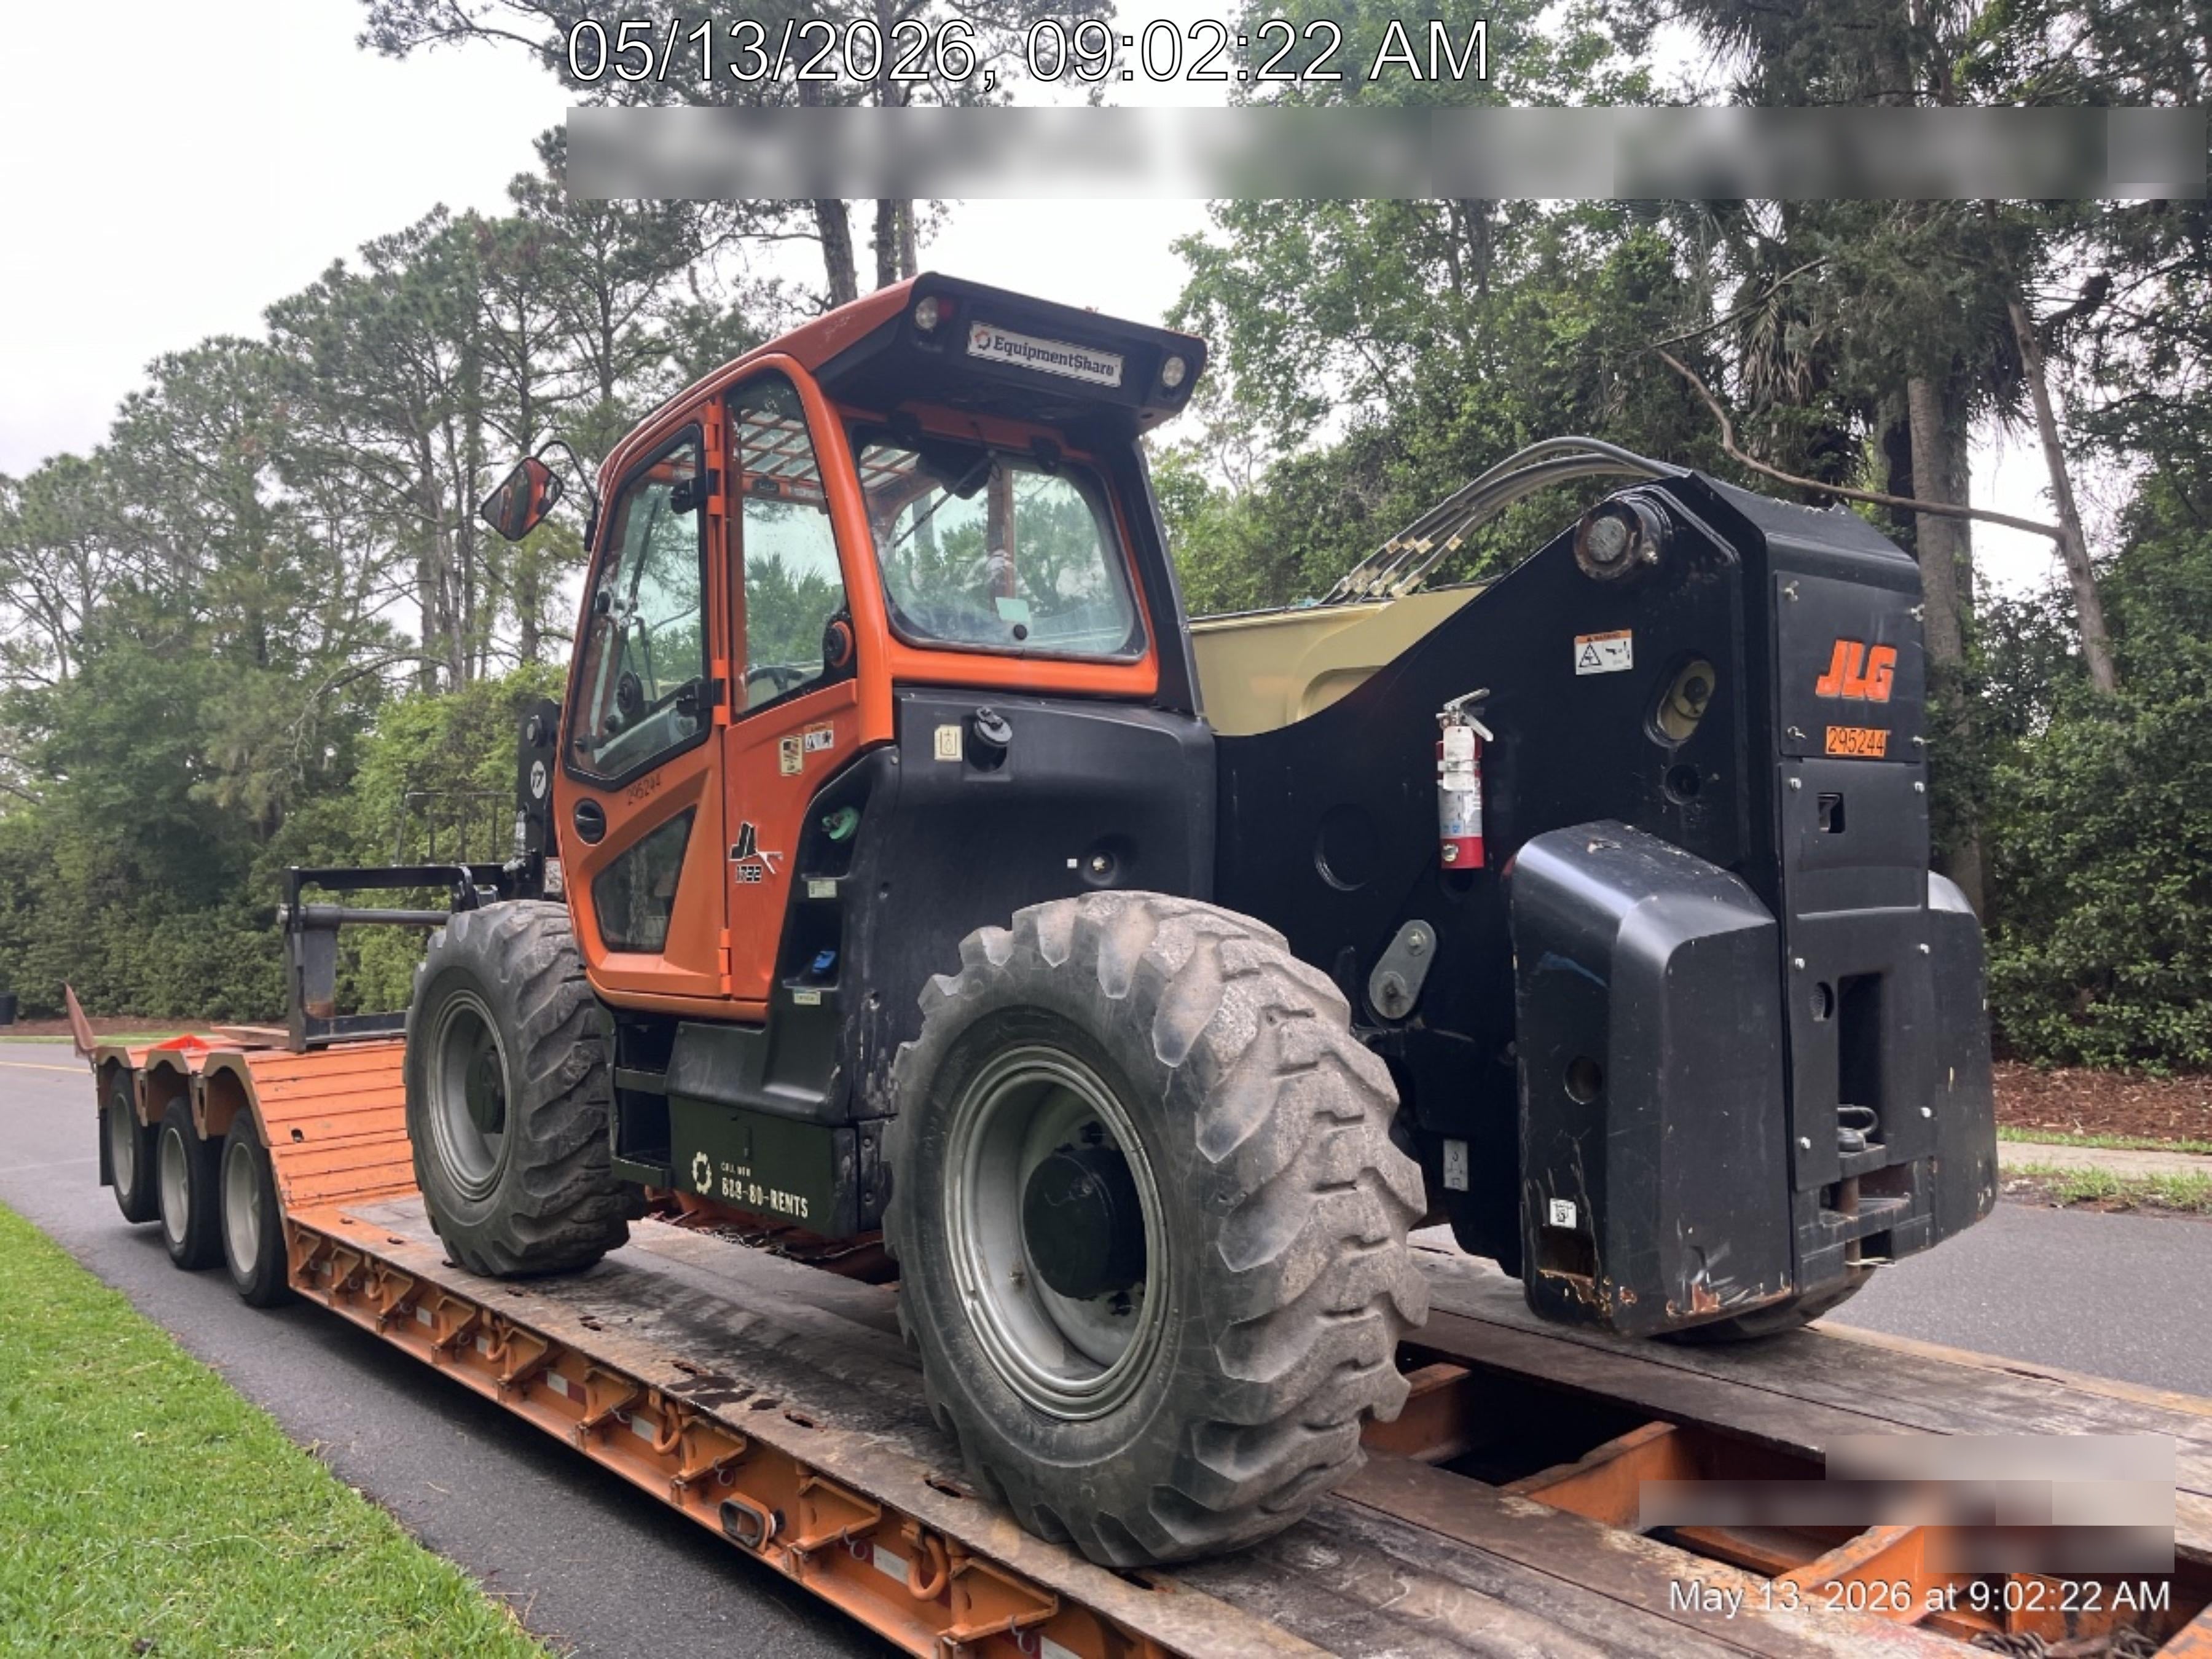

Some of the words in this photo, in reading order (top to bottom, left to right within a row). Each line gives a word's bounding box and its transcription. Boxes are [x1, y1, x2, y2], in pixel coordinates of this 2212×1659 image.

[993, 335, 1115, 377] EquipmentShare
[1816, 640, 1897, 702] JLG
[1827, 728, 1885, 753] 295244
